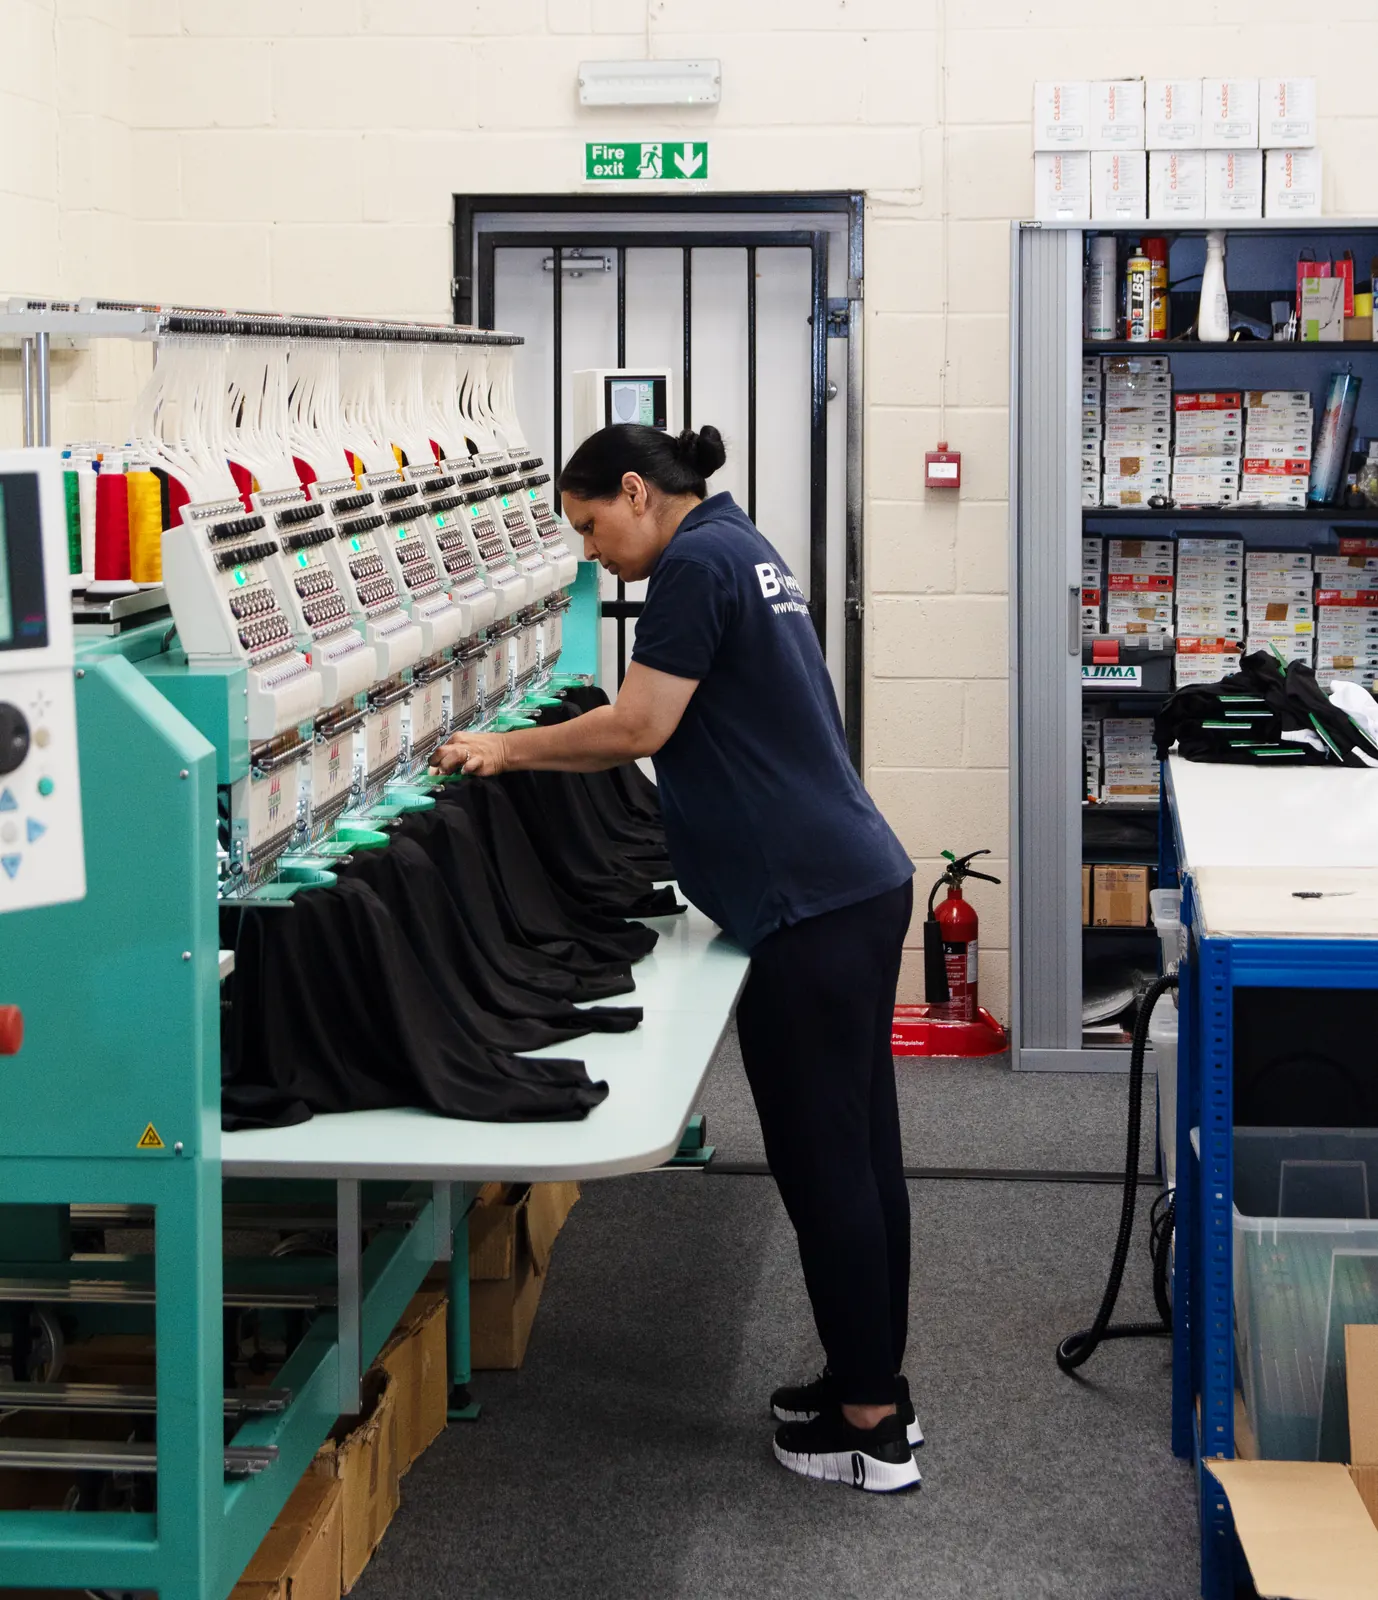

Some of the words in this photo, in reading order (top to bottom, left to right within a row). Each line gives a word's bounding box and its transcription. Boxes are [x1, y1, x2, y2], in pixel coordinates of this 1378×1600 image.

[592, 145, 625, 160] Fire
[593, 162, 625, 176] exit
[1132, 273, 1144, 301] LB5
[1082, 666, 1136, 677] AJIMA
